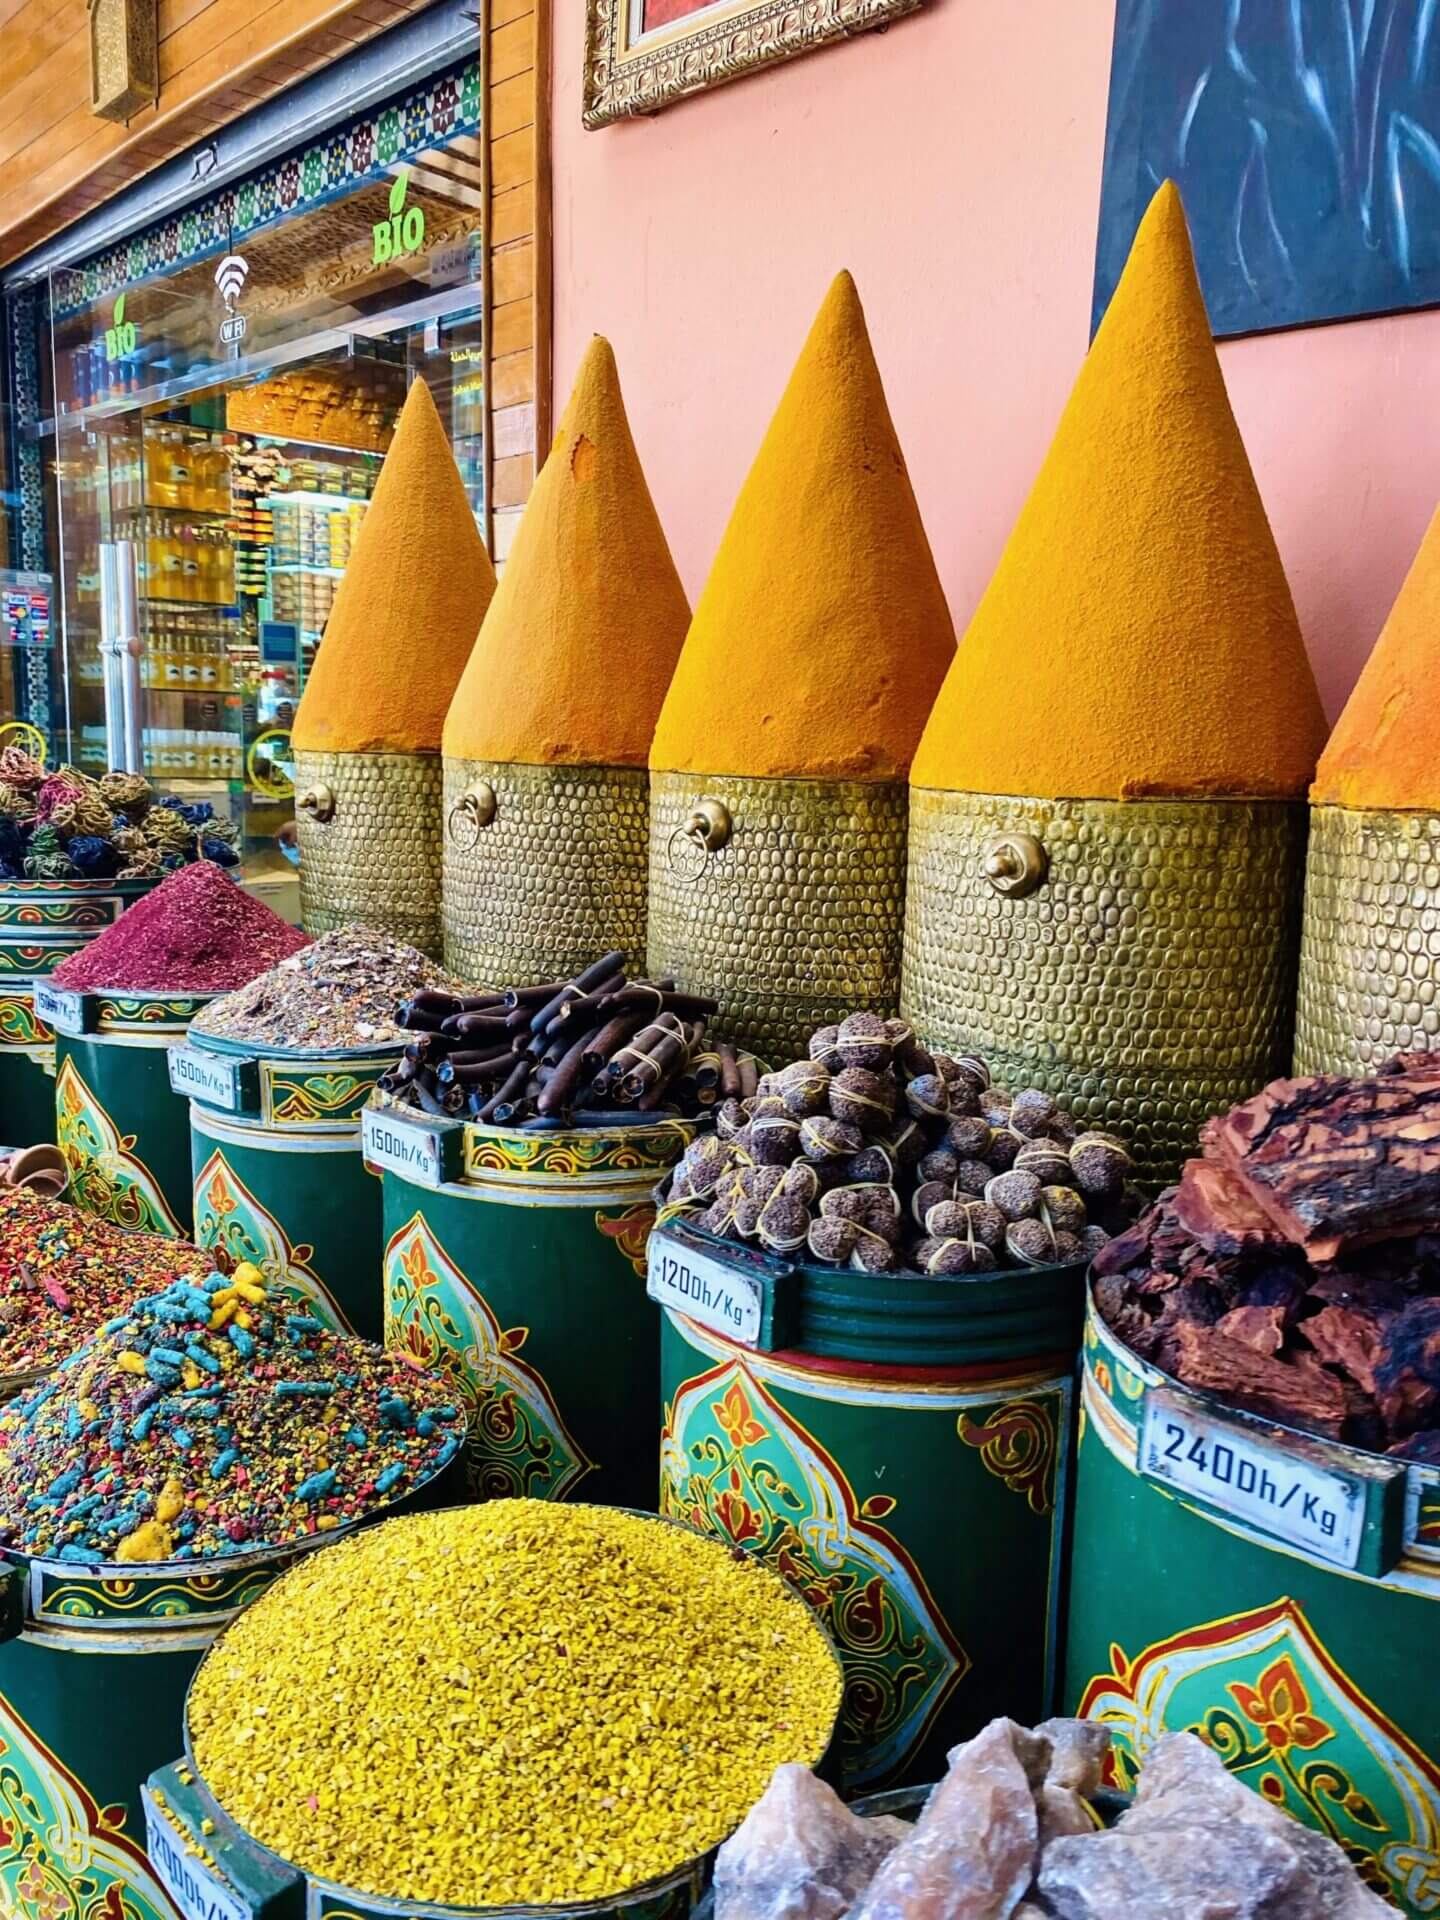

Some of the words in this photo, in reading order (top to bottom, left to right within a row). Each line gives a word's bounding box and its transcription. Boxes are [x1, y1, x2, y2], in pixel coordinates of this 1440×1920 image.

[373, 207, 425, 265] BIO
[105, 322, 136, 362] BIO
[371, 1125, 429, 1173] 150Dh/Kg
[661, 1255, 743, 1326] 120Dh/Kg
[1163, 1422, 1337, 1538] 240Dh/Kg
